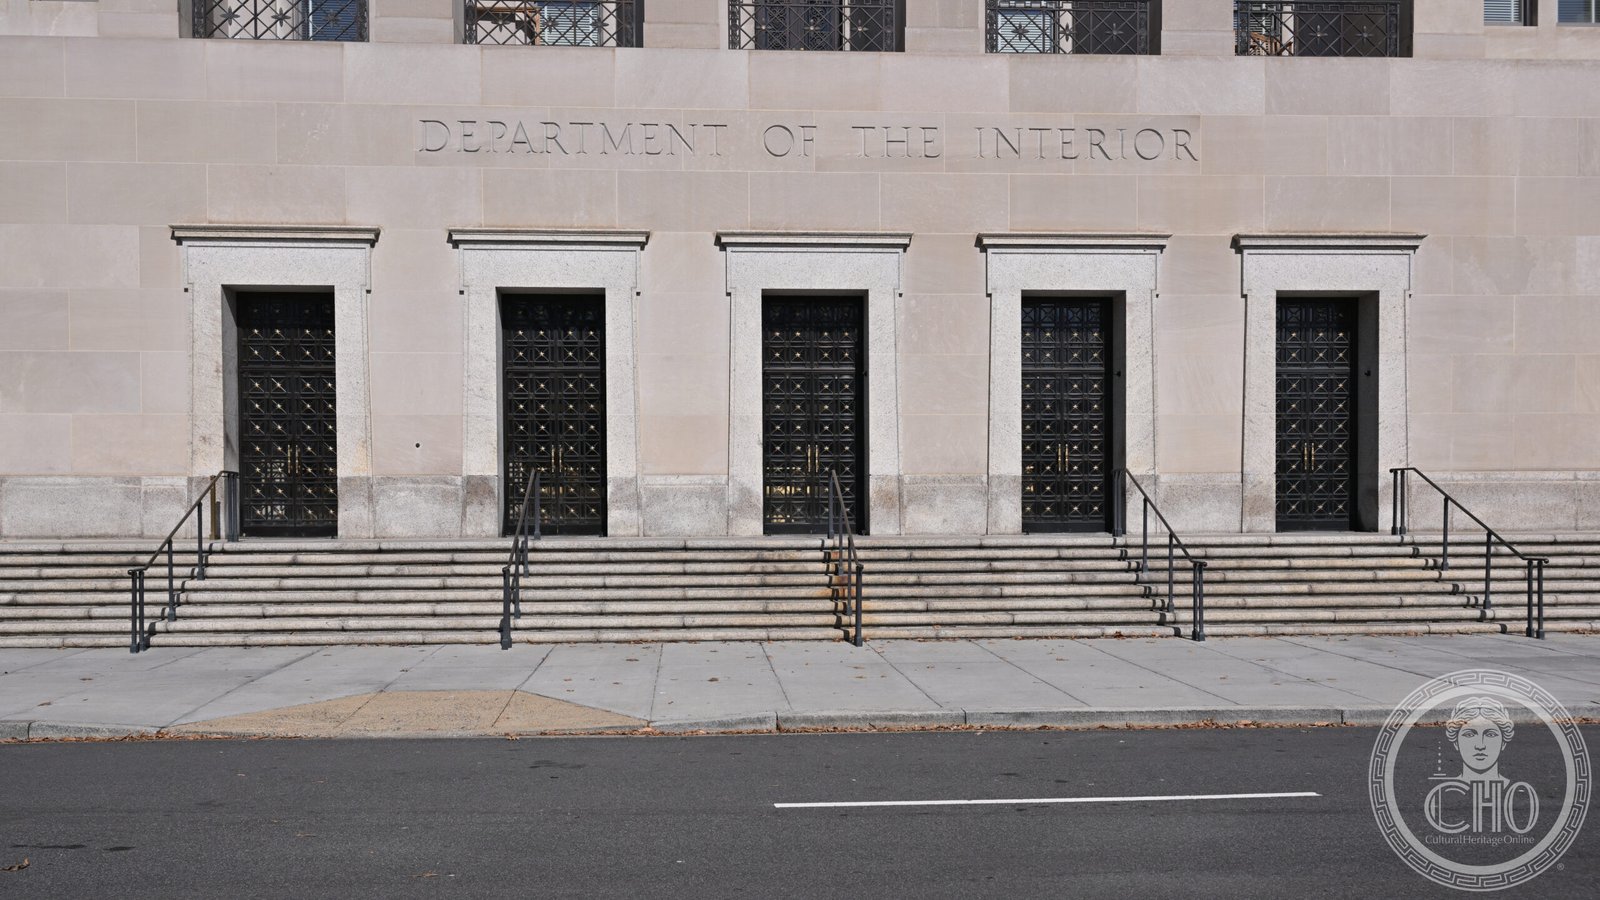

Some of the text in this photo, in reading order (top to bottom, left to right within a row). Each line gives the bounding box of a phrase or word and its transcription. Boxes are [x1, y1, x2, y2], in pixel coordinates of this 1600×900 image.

[418, 119, 1199, 161] DEPARTMENT OF THE INTERIOR
